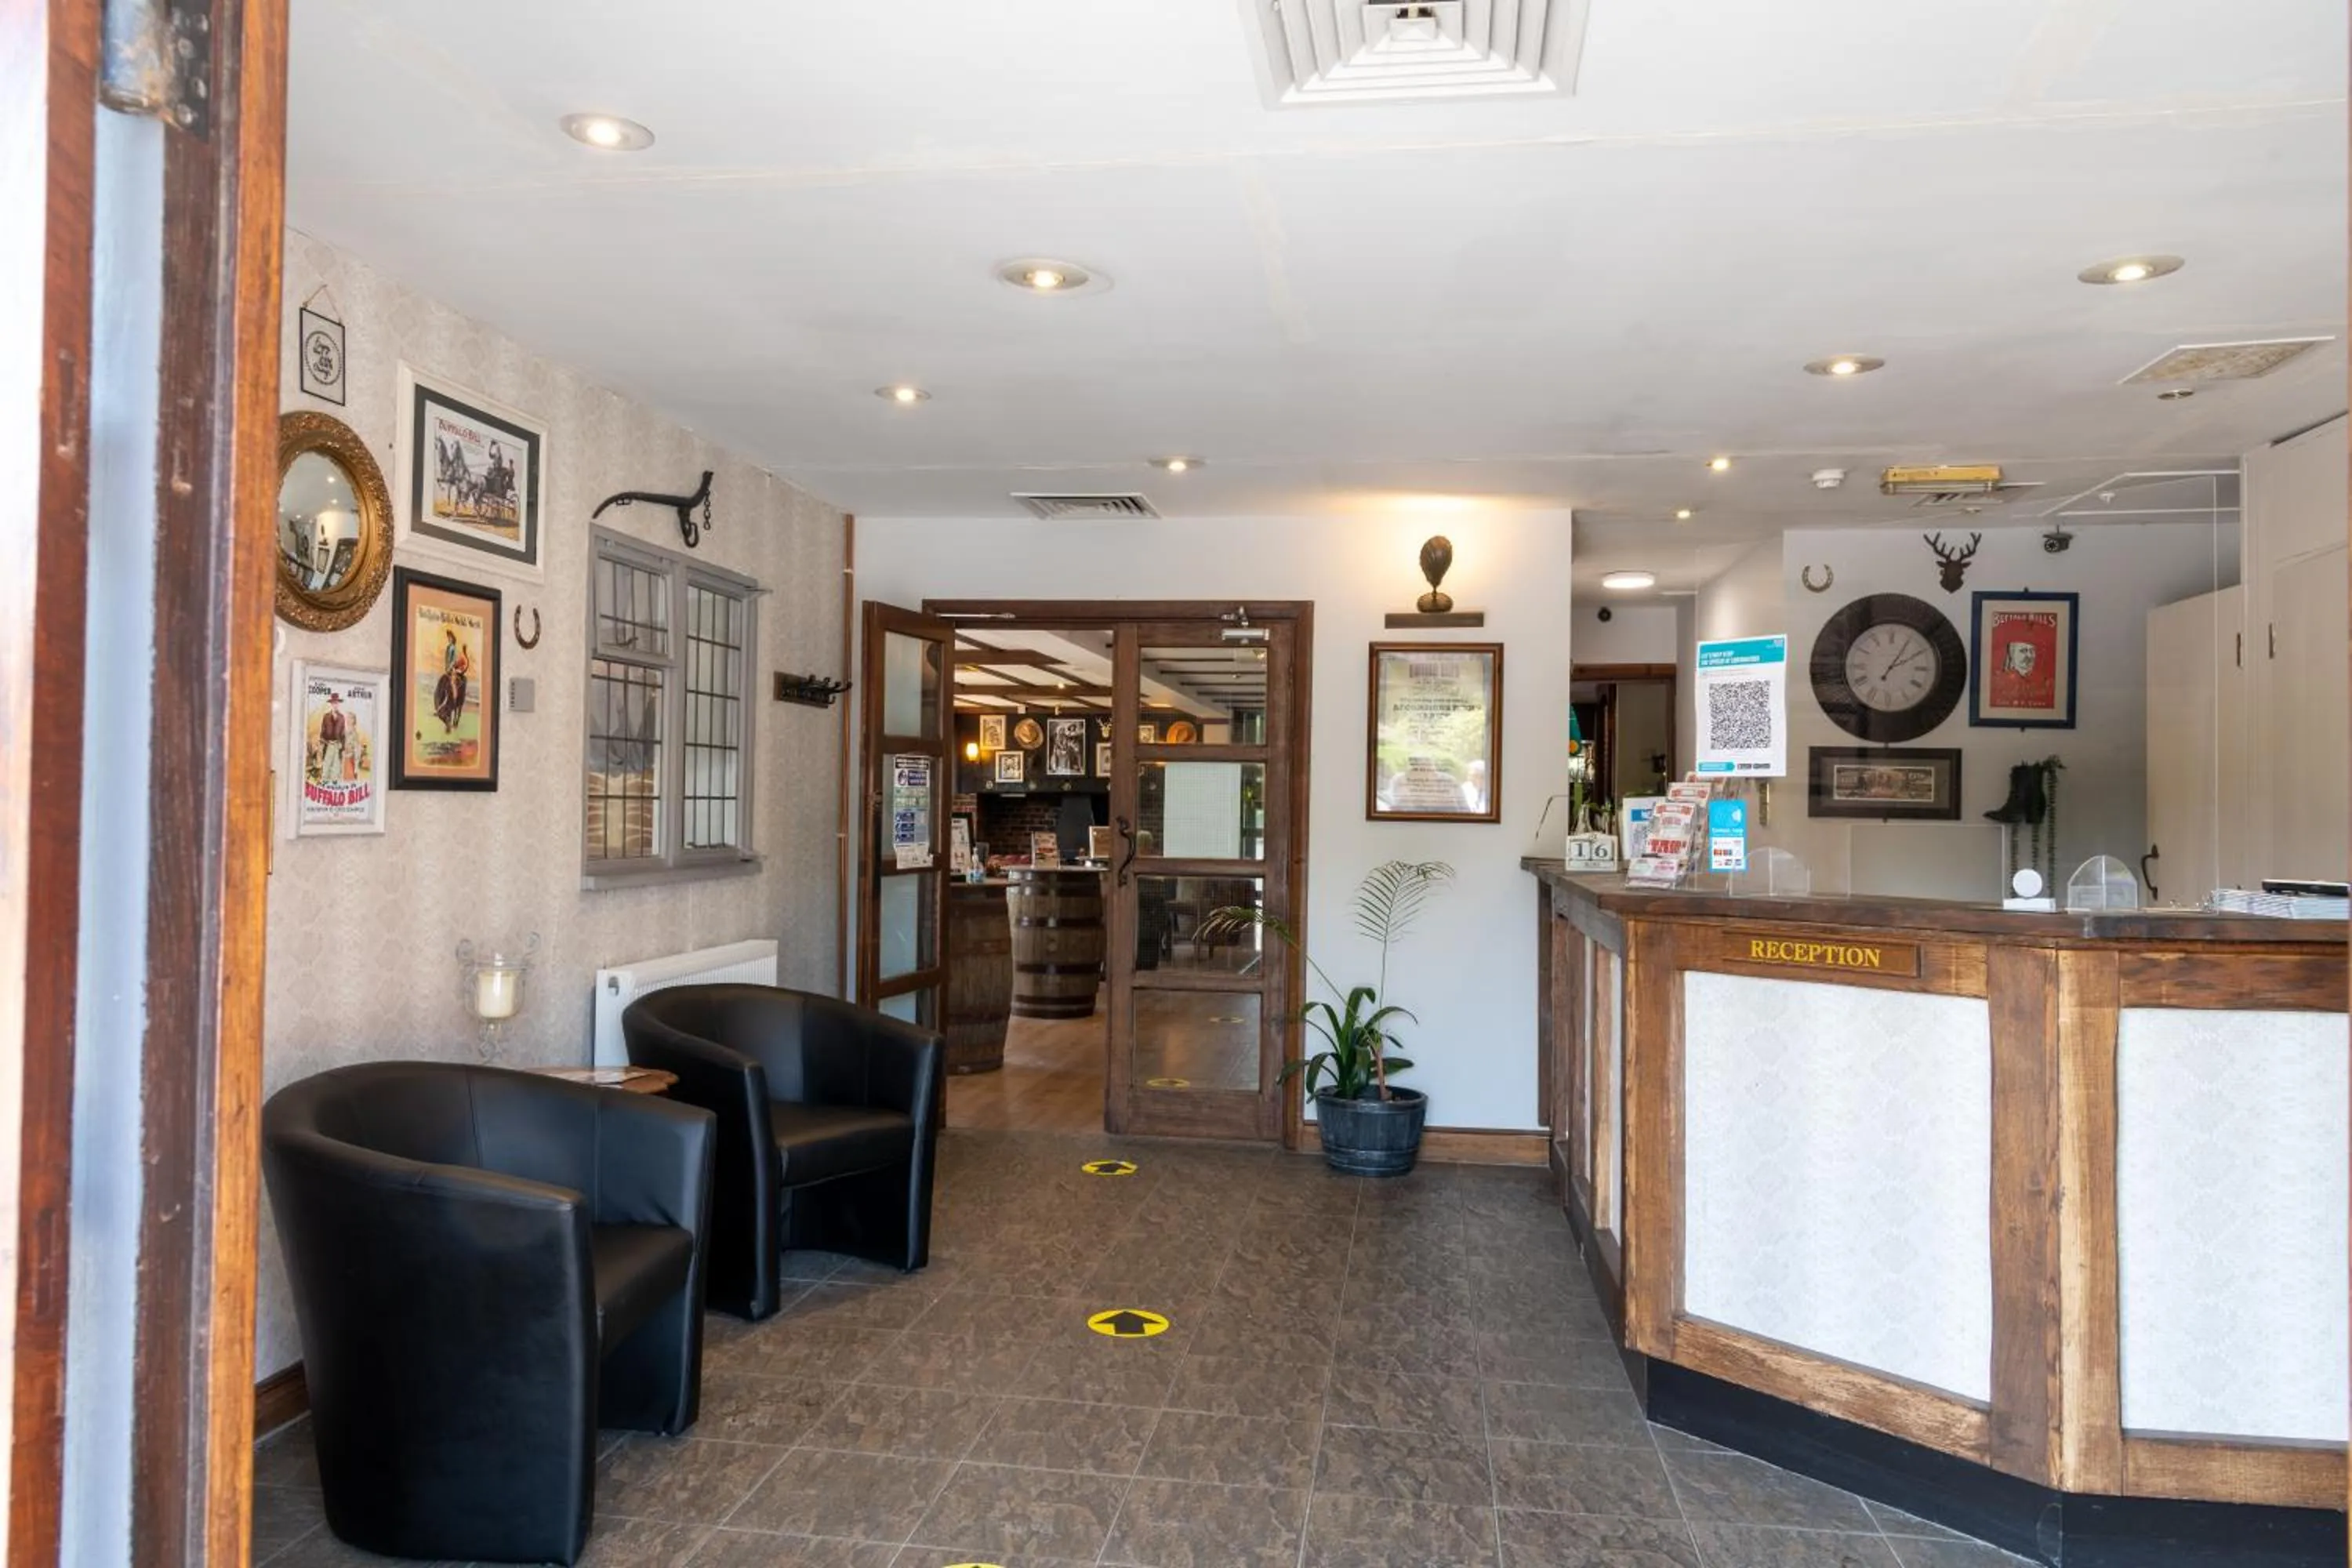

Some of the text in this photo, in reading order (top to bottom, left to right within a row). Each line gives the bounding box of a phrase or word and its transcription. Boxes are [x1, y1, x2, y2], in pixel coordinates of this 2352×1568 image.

[305, 781, 345, 807] BUFFALO
[348, 782, 370, 804] BILL
[1751, 939, 1882, 967] RECEPTION
